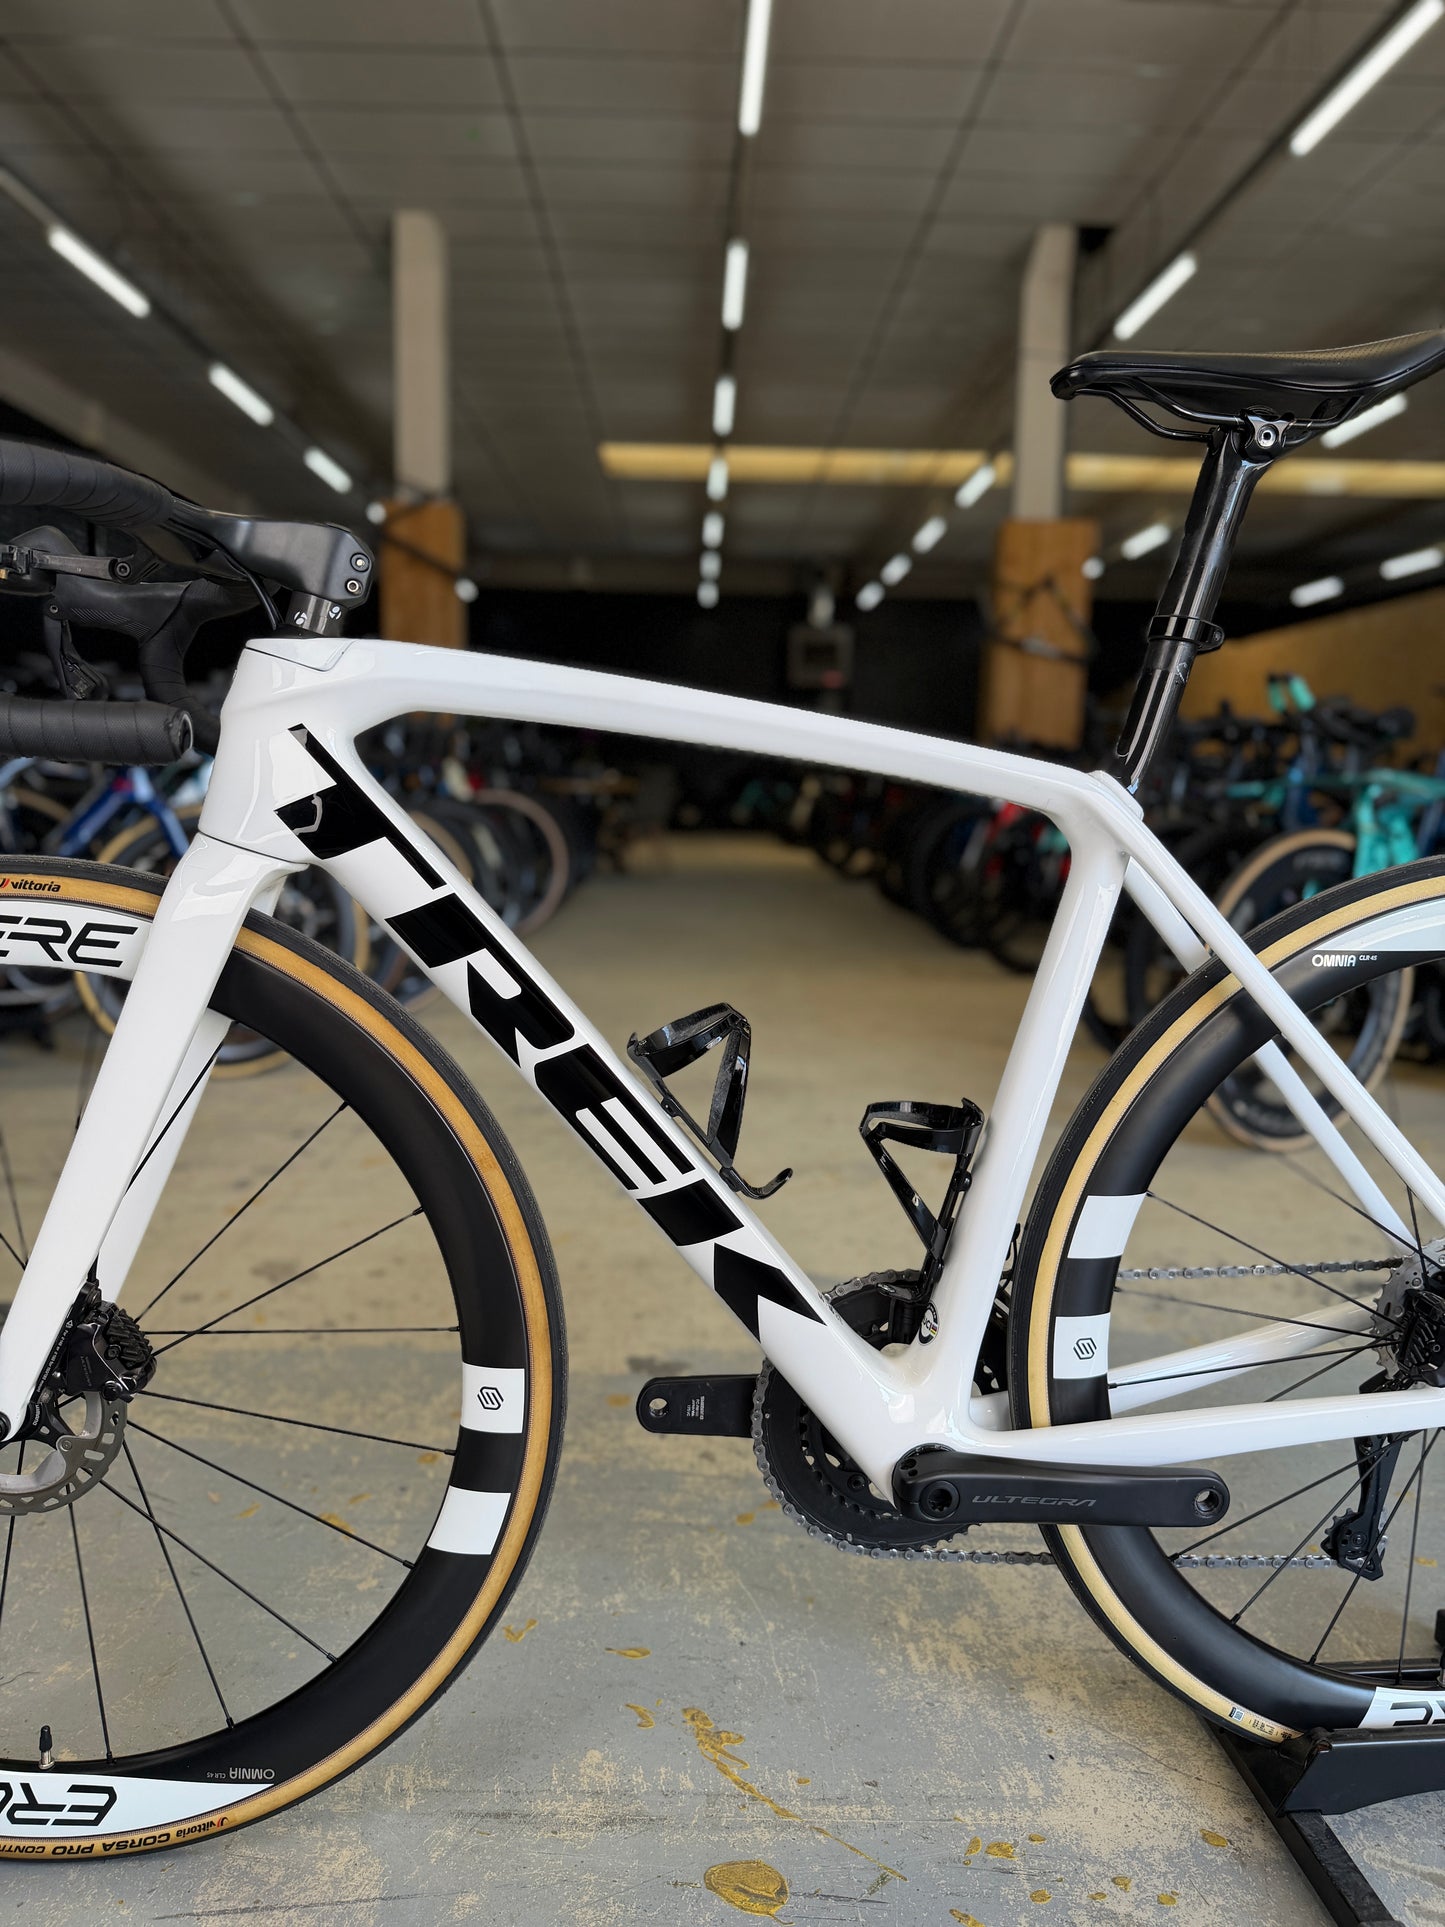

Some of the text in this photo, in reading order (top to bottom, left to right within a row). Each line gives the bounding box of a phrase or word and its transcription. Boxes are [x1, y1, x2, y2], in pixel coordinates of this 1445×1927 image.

[11, 879, 61, 892] vittoria
[1311, 954, 1356, 967] OMNIA
[275, 723, 827, 1342] TREK
[972, 1495, 1096, 1507] ULTEGRA
[229, 1767, 275, 1780] OMNIA
[0, 1782, 117, 1826] ER
[176, 1820, 216, 1837] vittoria
[102, 1833, 171, 1851] CORSA
[52, 1844, 94, 1855] PRO
